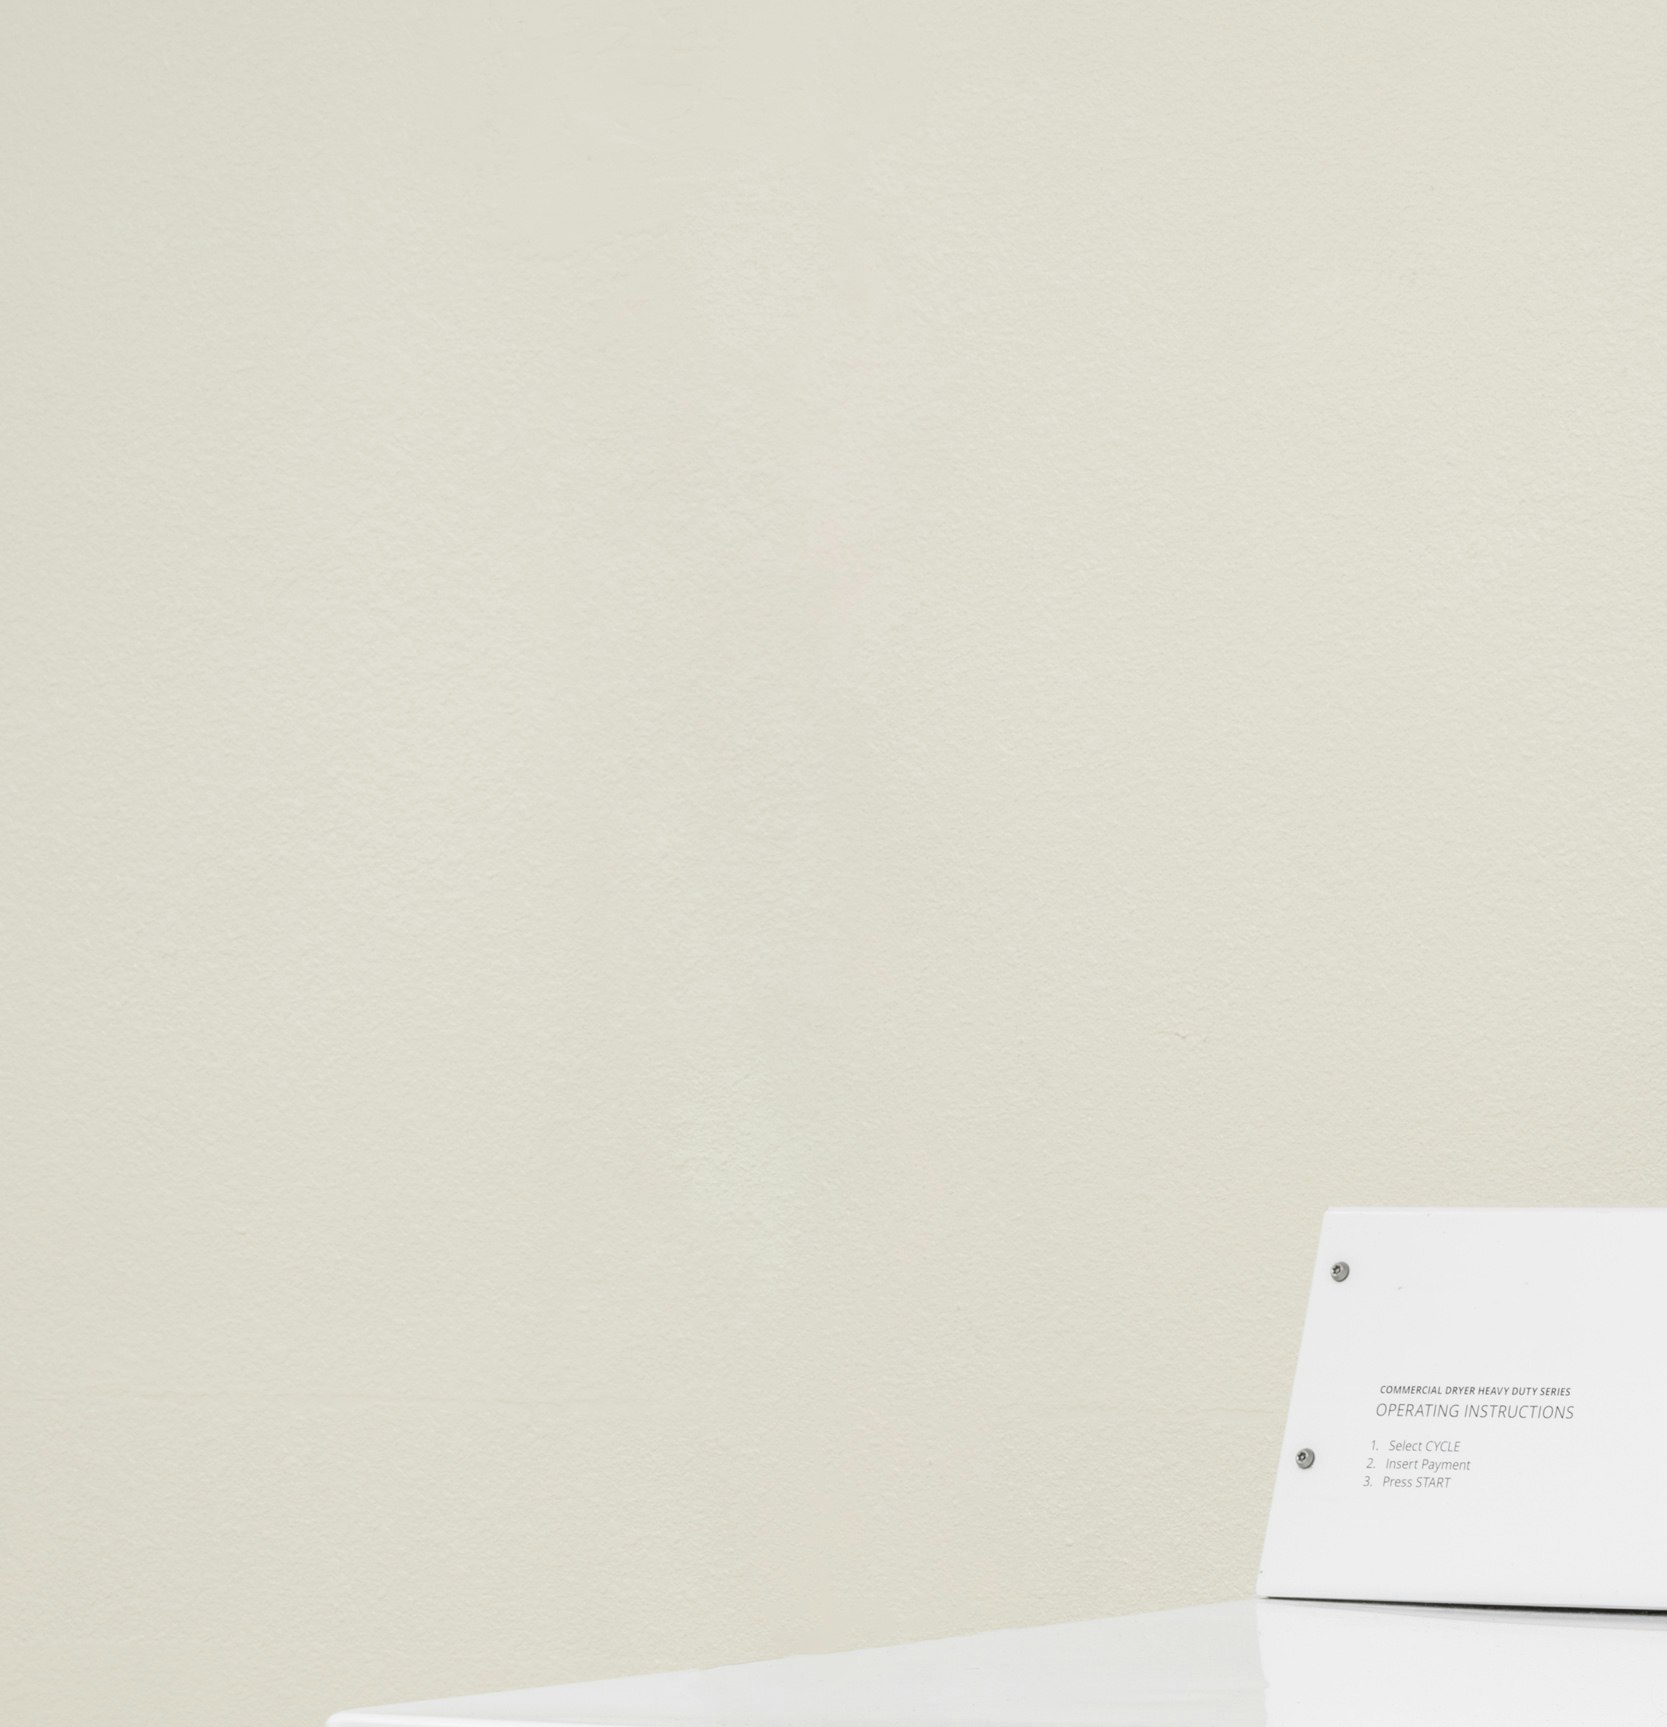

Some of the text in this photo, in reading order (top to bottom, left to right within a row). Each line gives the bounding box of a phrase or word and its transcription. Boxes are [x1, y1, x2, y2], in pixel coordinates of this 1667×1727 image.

[1380, 1385, 1571, 1396] COMMERCIAL DRYER HEAVY DUTY SERIES
[1376, 1403, 1574, 1419] OPERATING INSTRUCTIONS
[1371, 1440, 1461, 1452] 1. Select CYCLE
[1366, 1458, 1471, 1473] 2. Insert Payment
[1363, 1476, 1451, 1488] 3. Press START
